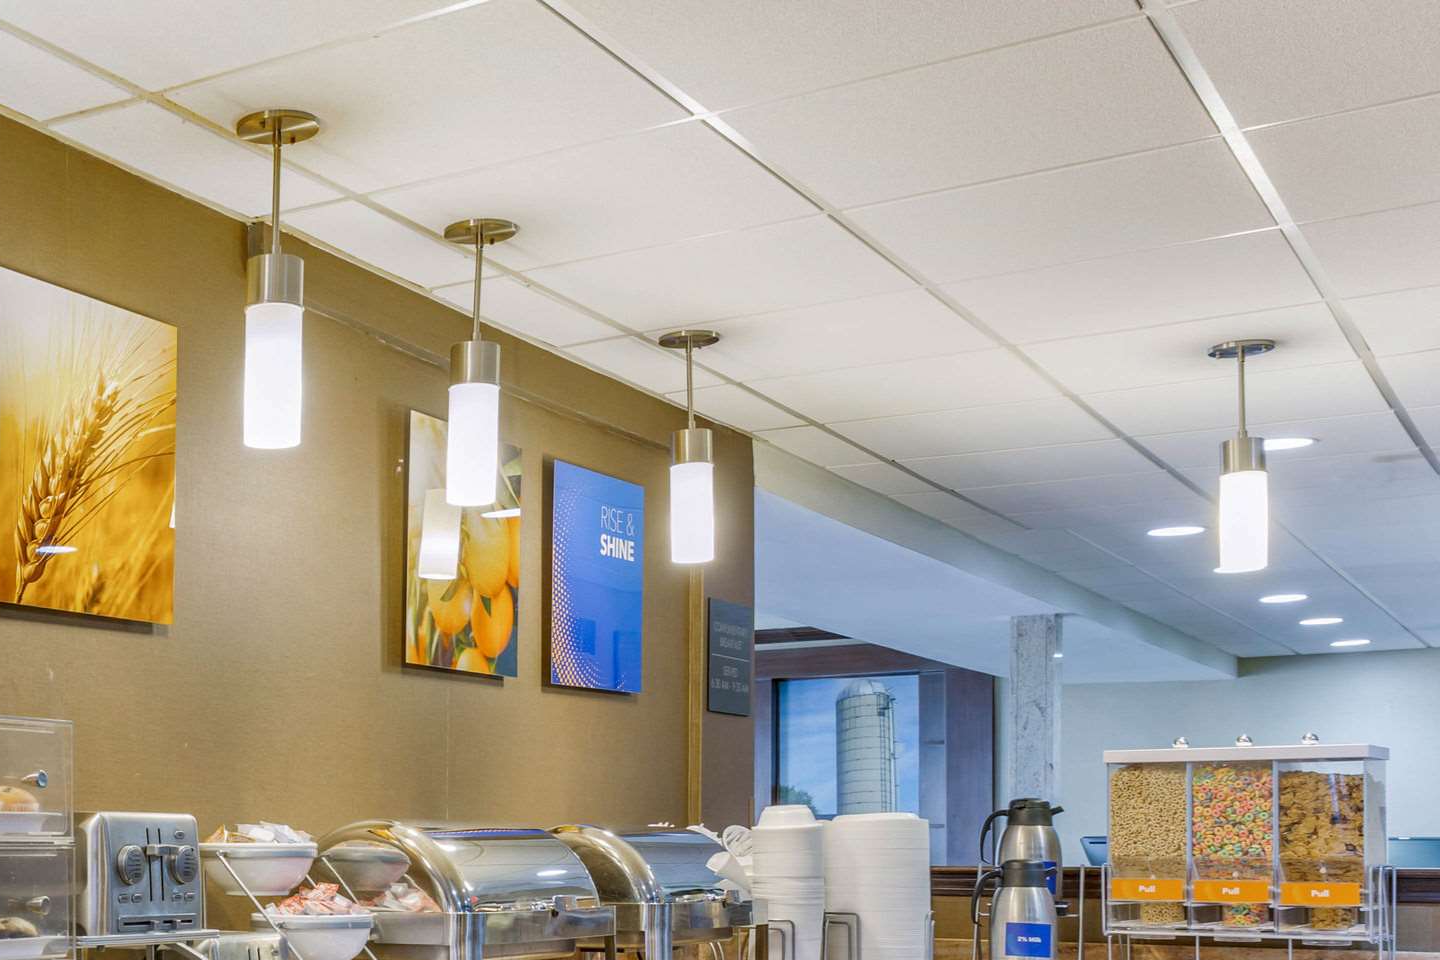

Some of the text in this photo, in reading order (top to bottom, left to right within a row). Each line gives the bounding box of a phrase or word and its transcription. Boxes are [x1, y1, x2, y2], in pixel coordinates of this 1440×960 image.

[601, 505, 635, 537] RISE &
[600, 533, 635, 562] SHINE
[1138, 884, 1156, 893] Pull
[1222, 887, 1240, 896] Pull
[1311, 889, 1329, 898] Pull
